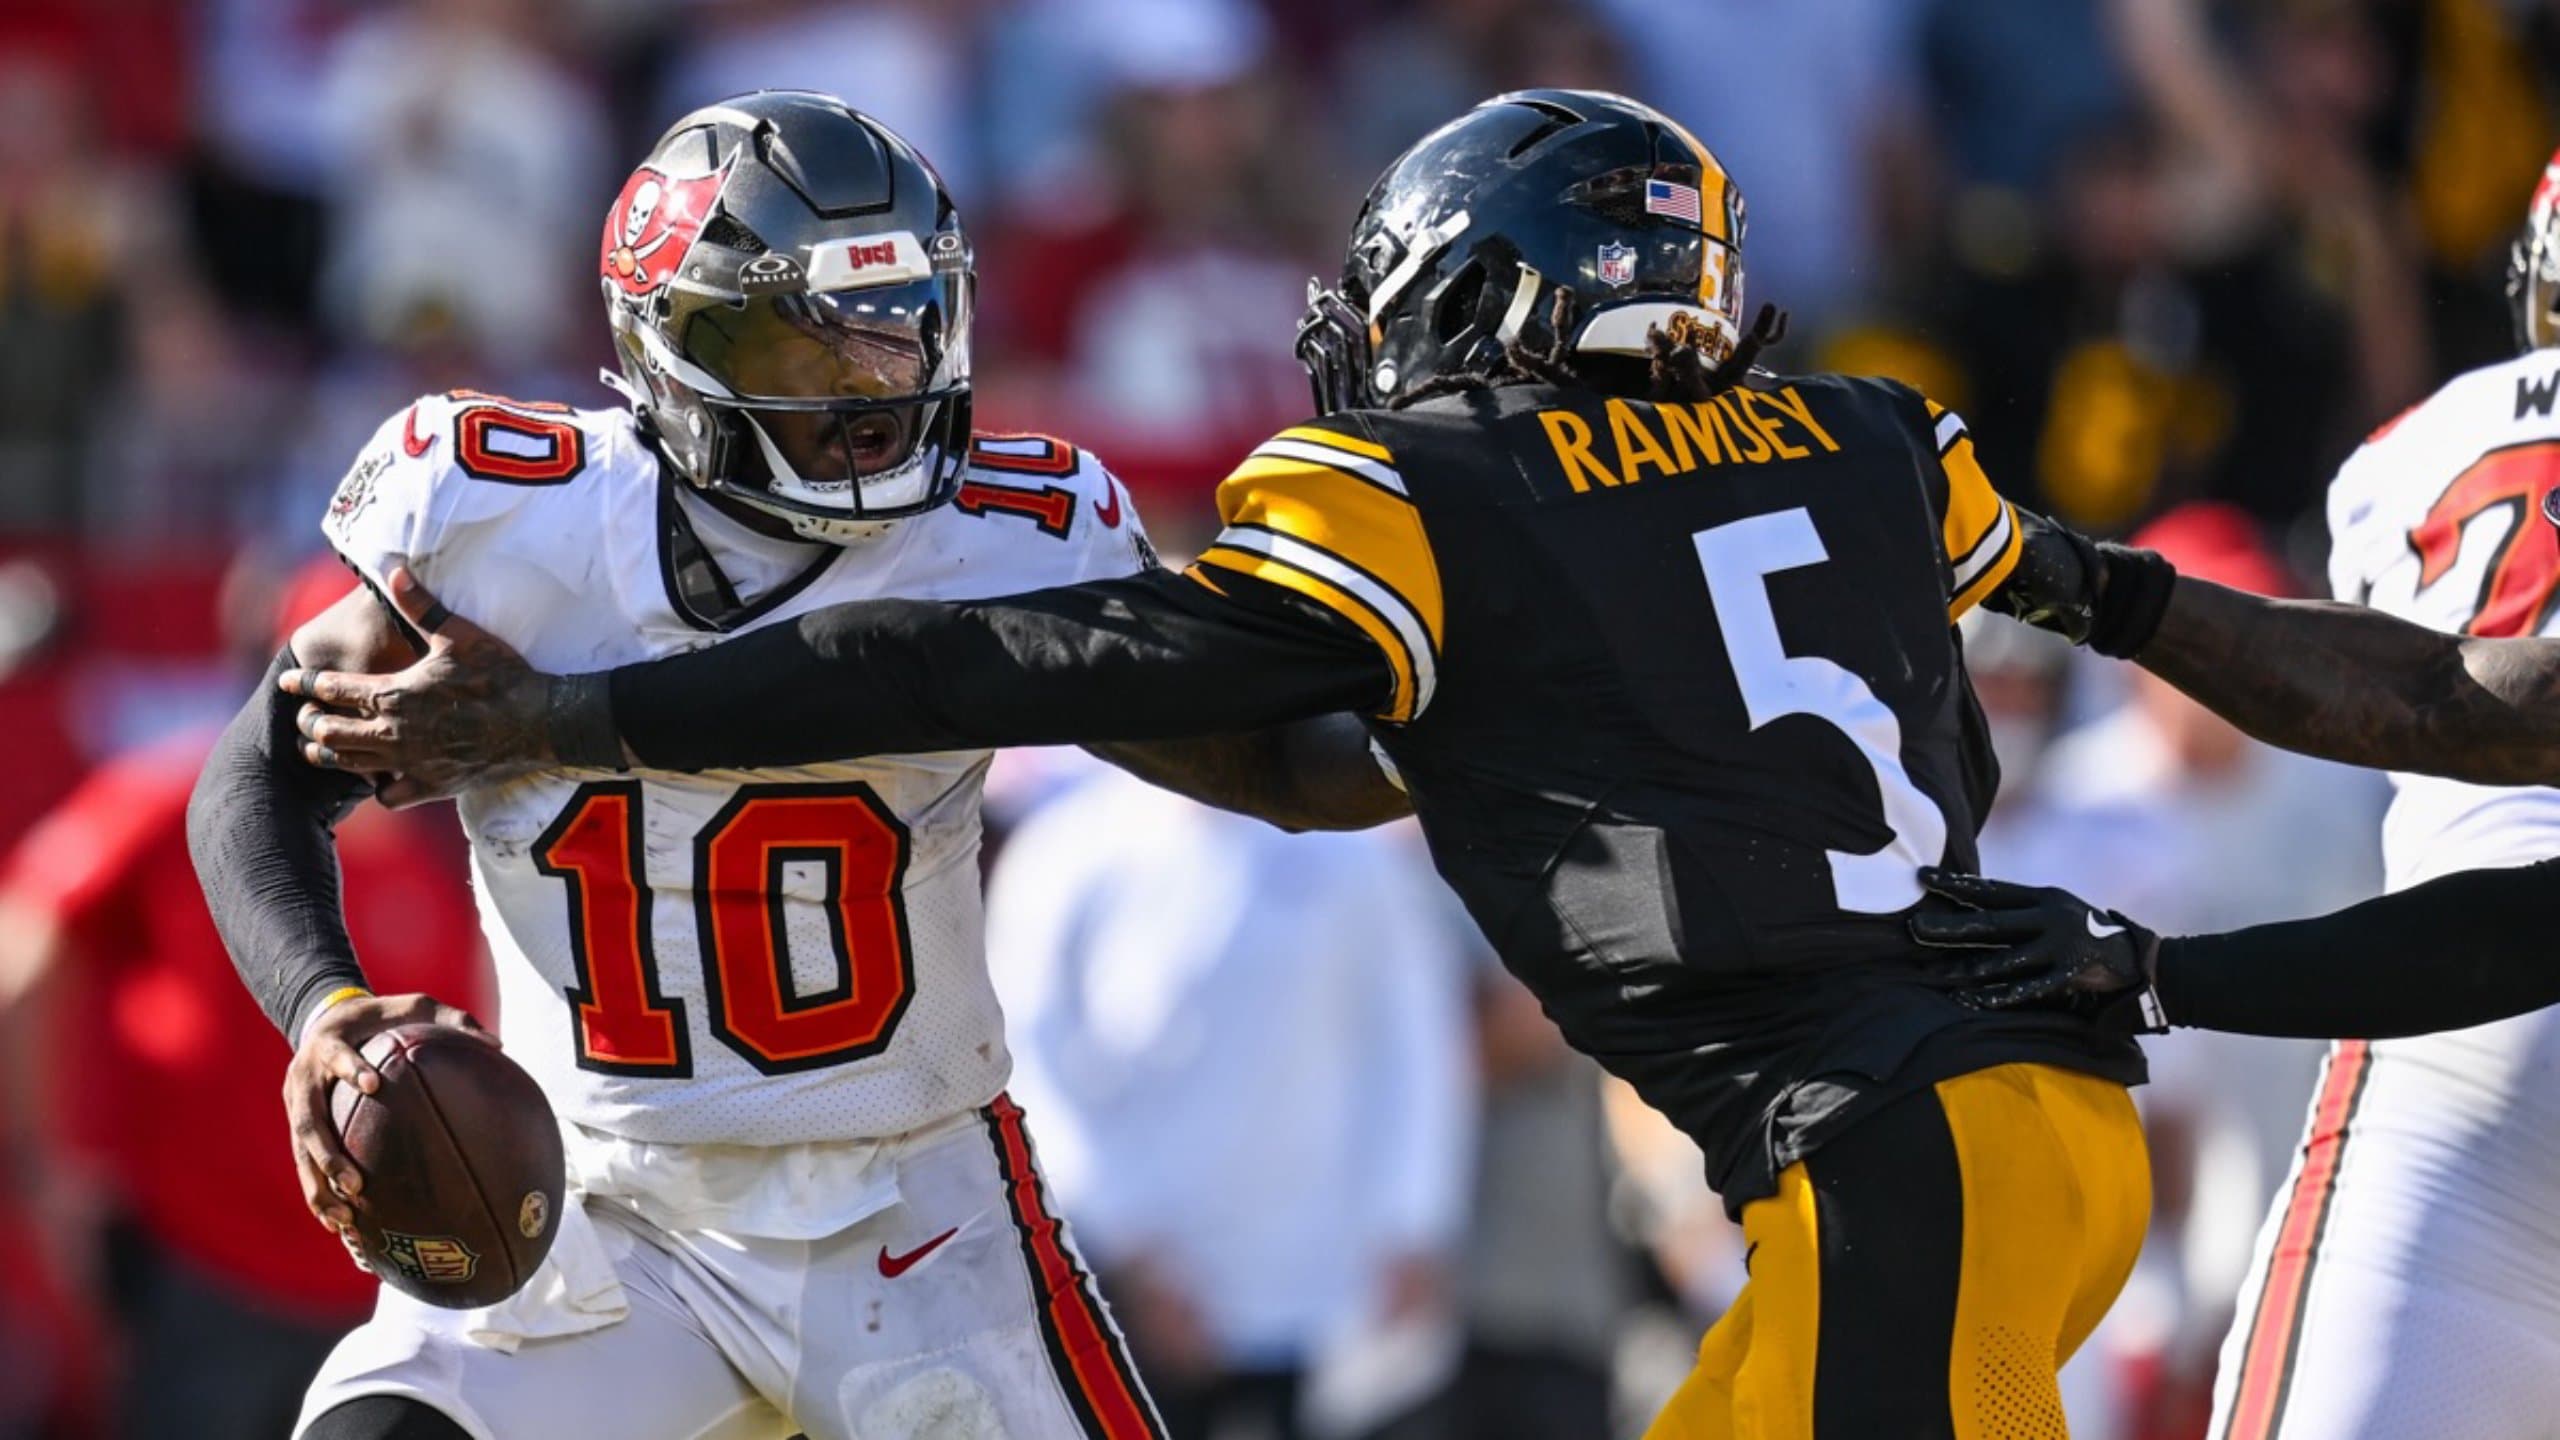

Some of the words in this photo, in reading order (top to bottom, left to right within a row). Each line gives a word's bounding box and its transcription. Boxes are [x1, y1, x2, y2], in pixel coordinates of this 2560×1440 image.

[741, 271, 799, 284] OAKLEY
[1603, 261, 1630, 280] NFL
[1538, 385, 1840, 493] RAMSEY
[1692, 506, 1947, 914] 5
[530, 779, 916, 1079] 10
[419, 1238, 465, 1279] NFL
